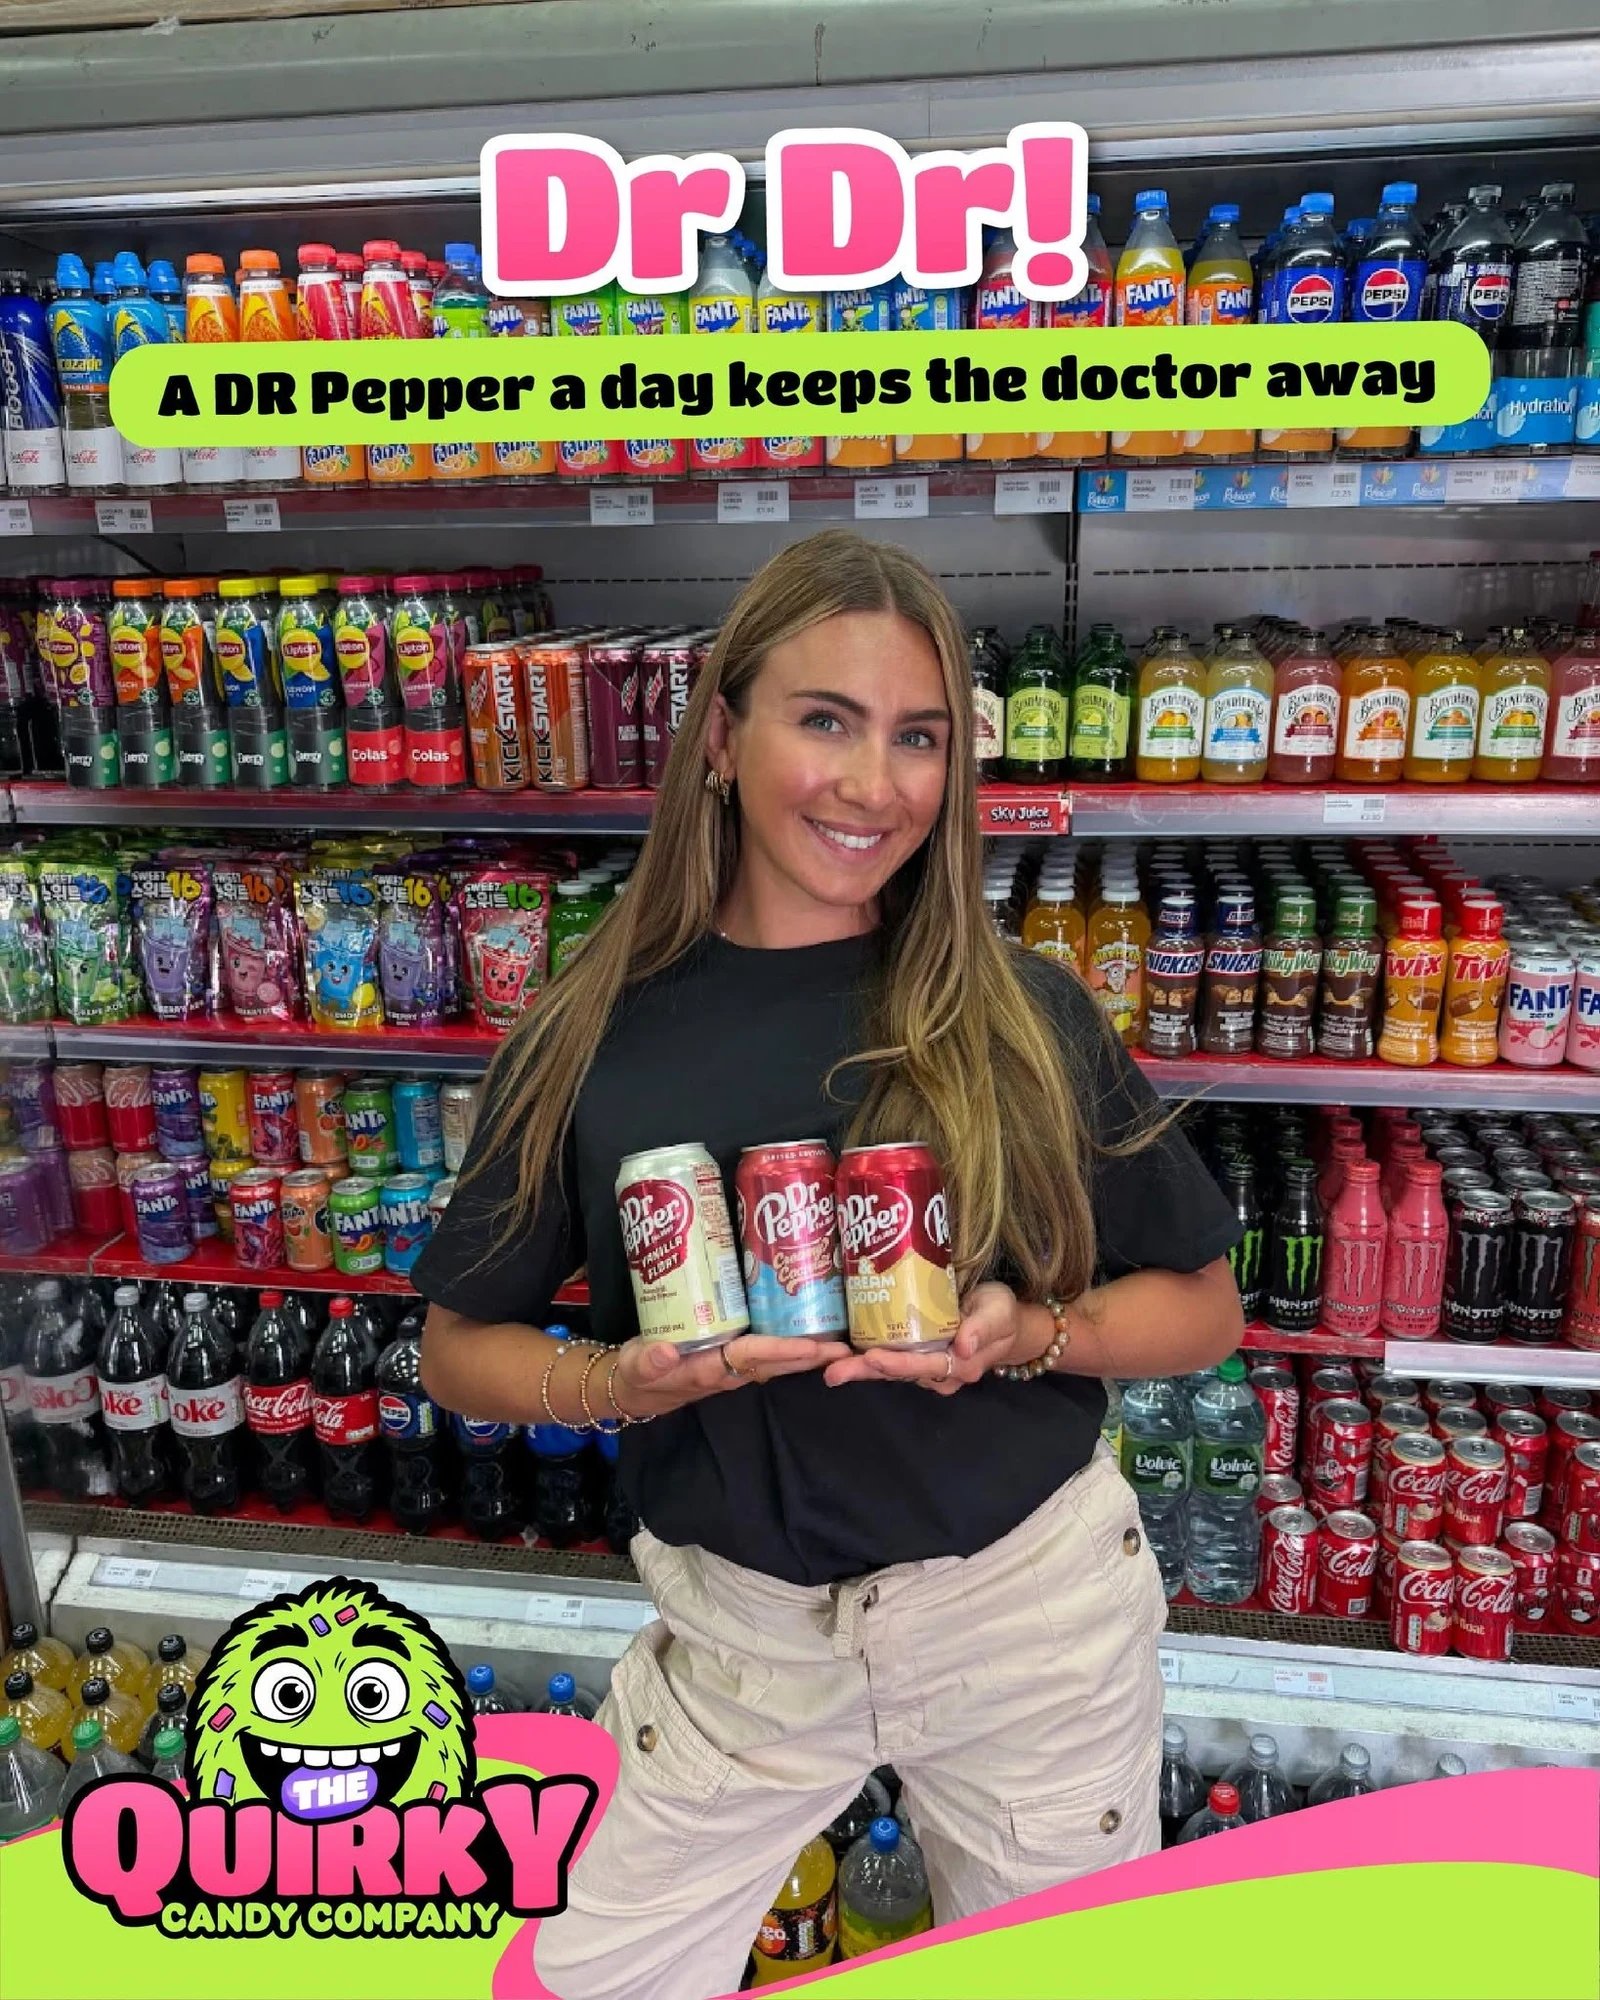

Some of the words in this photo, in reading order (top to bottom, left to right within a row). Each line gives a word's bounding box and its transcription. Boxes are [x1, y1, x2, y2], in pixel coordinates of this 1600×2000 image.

[1126, 279, 1176, 304] FANTA
[1290, 295, 1333, 308] PEPSI
[1364, 289, 1407, 301] PEPSI
[564, 302, 602, 319] FANTA
[626, 298, 665, 317] FANTA
[695, 301, 739, 325] FANTA
[765, 301, 811, 325] FANTA
[491, 661, 524, 784] KICKSTART
[351, 748, 388, 761] Colas
[411, 748, 450, 762] Colas
[166, 869, 202, 901] 16
[242, 872, 272, 904] 16
[333, 879, 375, 906] 16
[404, 877, 432, 908] 16
[502, 880, 542, 911] 16
[153, 1088, 193, 1106] FANTA
[137, 1194, 179, 1214] FANTA
[234, 1199, 276, 1218] FANTA
[785, 1181, 821, 1215] Dr
[845, 1193, 879, 1223] Dr
[640, 1234, 684, 1268] VANILLA
[647, 1252, 679, 1280] FLOAT
[858, 1257, 873, 1276] &
[1135, 1454, 1182, 1471] Volvic
[1210, 1456, 1257, 1473] Volvic
